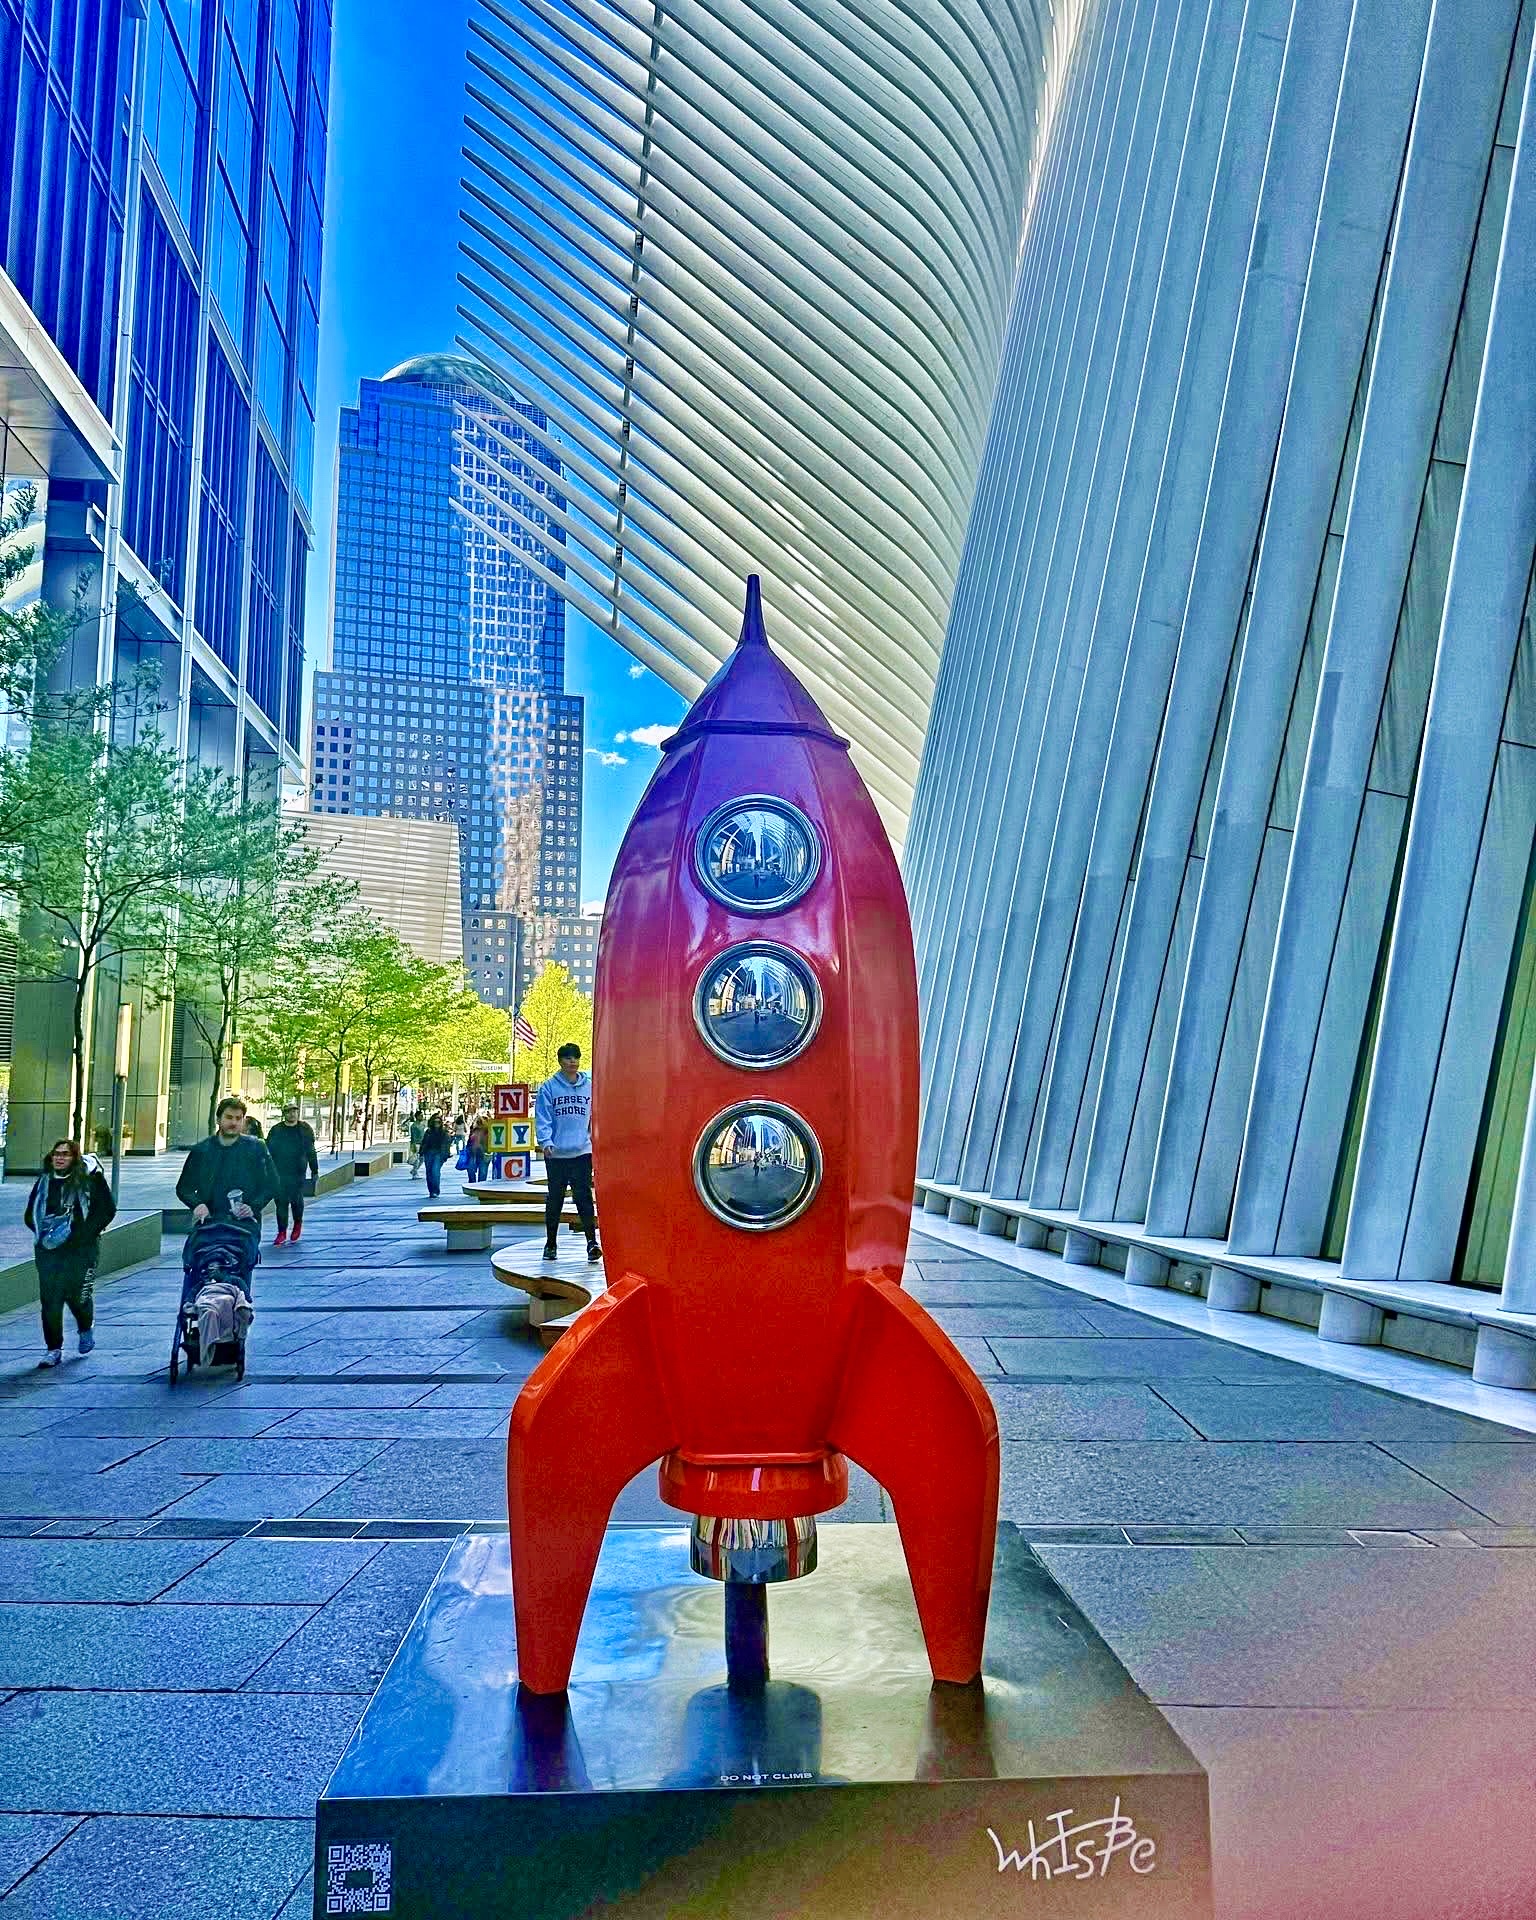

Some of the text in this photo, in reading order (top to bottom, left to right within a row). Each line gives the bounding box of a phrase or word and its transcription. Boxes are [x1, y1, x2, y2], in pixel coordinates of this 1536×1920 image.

[500, 1092, 522, 1111] N
[552, 1095, 590, 1107] JERSEY
[555, 1106, 586, 1117] SHORE
[492, 1126, 505, 1145] Y
[513, 1125, 530, 1144] Y
[504, 1159, 523, 1179] C
